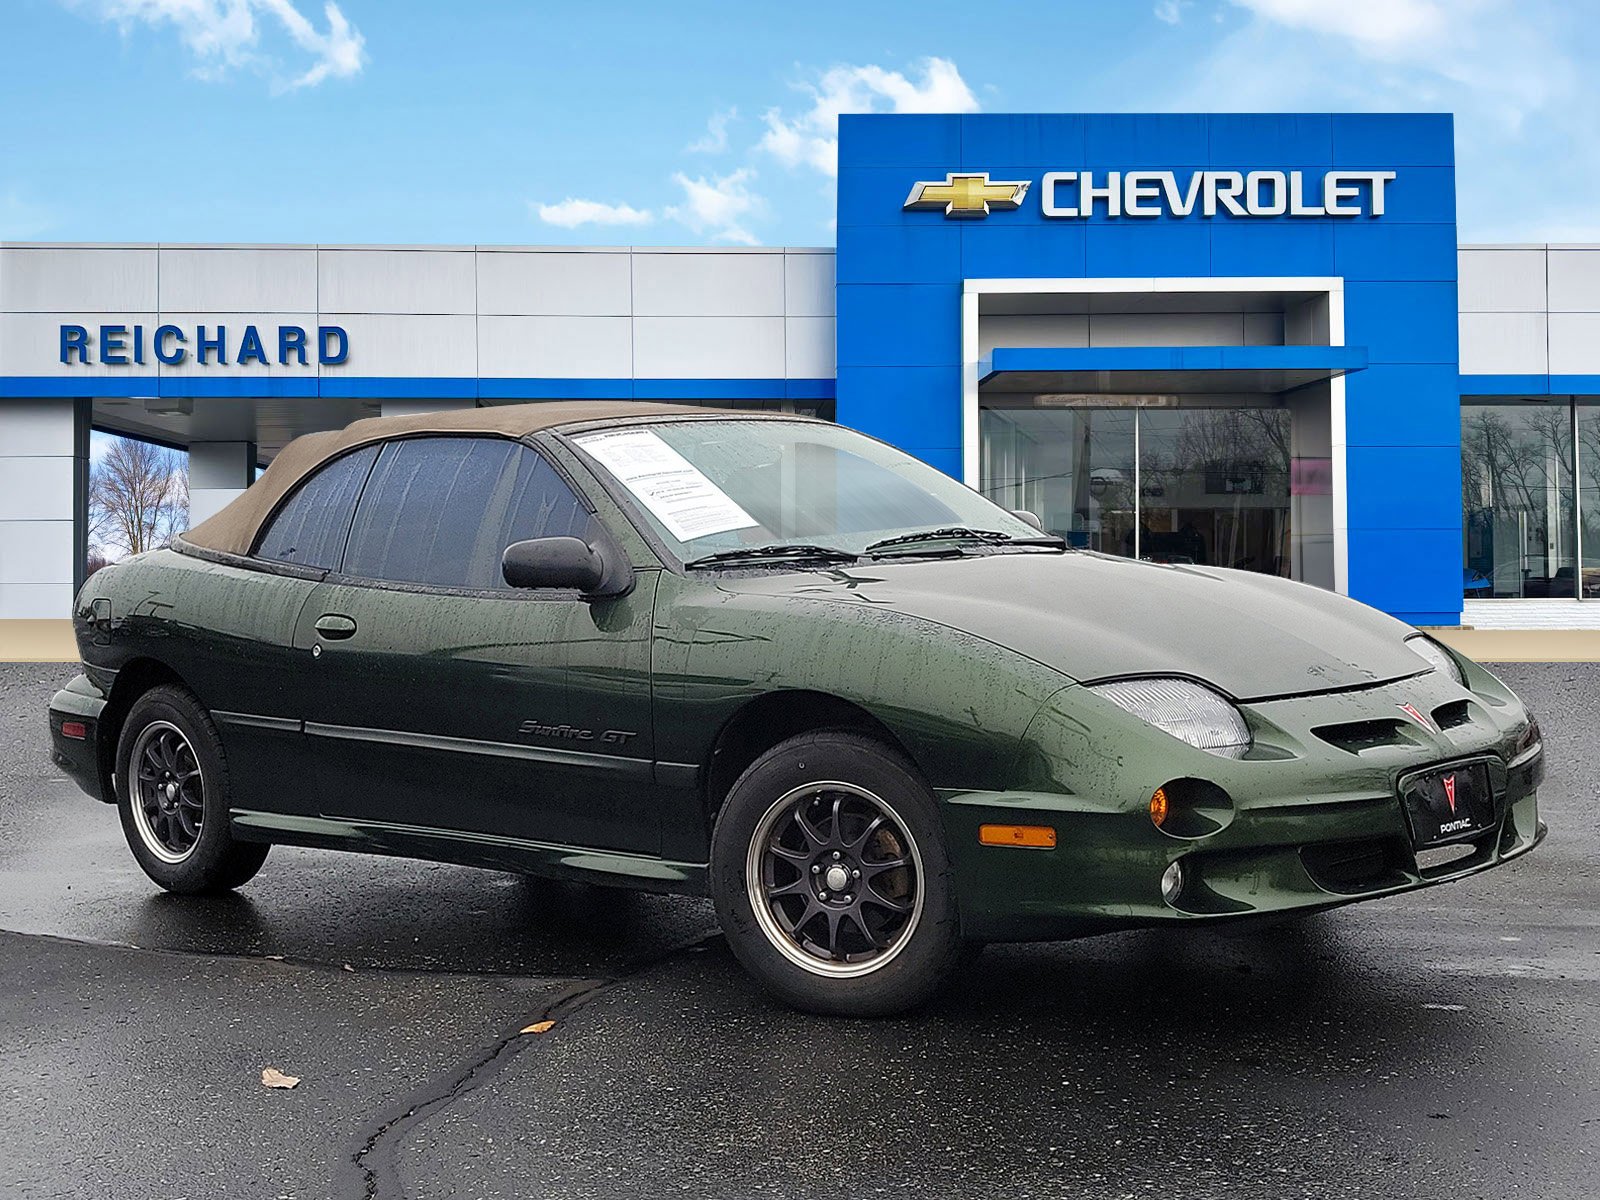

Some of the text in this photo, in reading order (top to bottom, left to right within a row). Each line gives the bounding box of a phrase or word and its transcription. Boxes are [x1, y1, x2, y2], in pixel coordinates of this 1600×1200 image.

[1041, 170, 1397, 217] CHEVROLET
[59, 324, 350, 365] REICHARD
[600, 729, 637, 744] GT
[1440, 817, 1472, 834] PONTIAC
